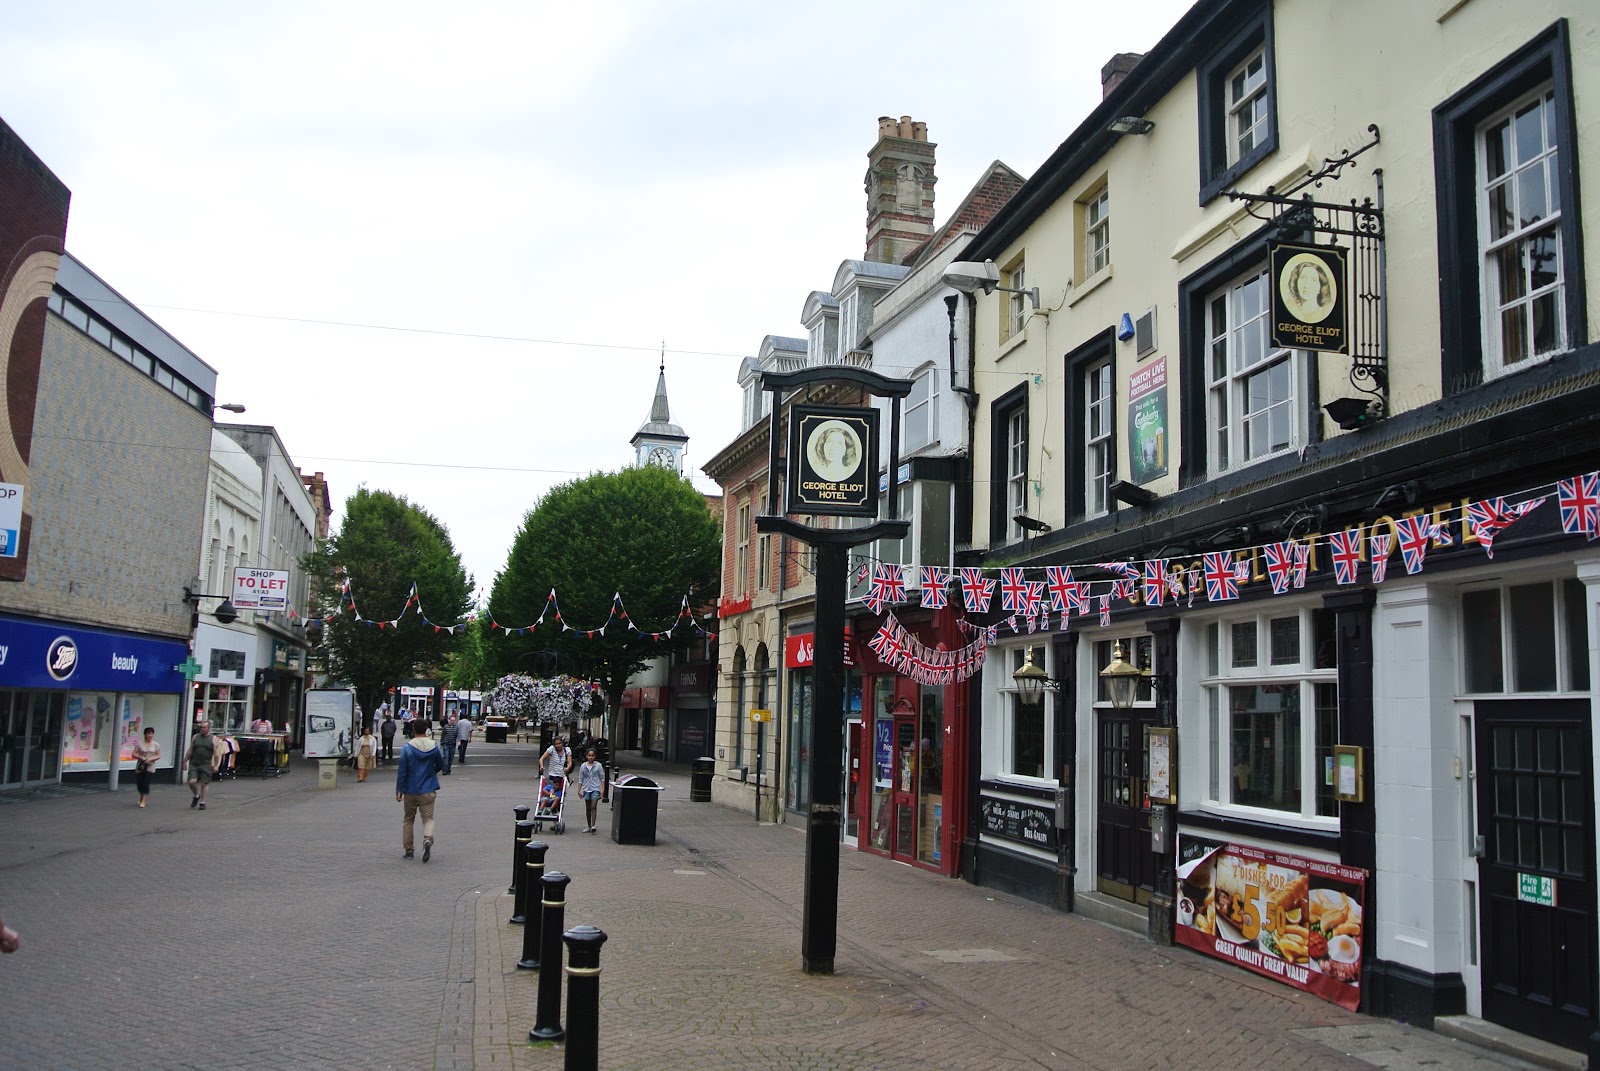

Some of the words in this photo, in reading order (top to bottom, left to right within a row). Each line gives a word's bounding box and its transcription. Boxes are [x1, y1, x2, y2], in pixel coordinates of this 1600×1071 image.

[1278, 323, 1313, 334] GEORGE
[1316, 327, 1341, 337] ELIOT
[1295, 334, 1324, 345] HOTEL
[1130, 380, 1152, 397] FOOTBALL
[1152, 373, 1165, 386] HERE
[802, 481, 837, 491] GEORGE
[839, 483, 864, 492] ELIOT
[819, 491, 848, 500] HOTEL
[250, 570, 275, 578] SHOP
[237, 577, 256, 588] TO
[260, 578, 286, 590] LET
[111, 652, 139, 674] beauty
[1233, 865, 1238, 878] 2
[1240, 866, 1268, 887] DISHES
[1269, 872, 1286, 890] FOR
[1340, 868, 1349, 878] FISH
[1353, 871, 1364, 881] CHIPS
[1522, 873, 1538, 886] Fire
[1522, 884, 1538, 895] exit
[1520, 893, 1537, 903] Keep
[1536, 896, 1552, 906] clear
[1215, 938, 1236, 957] GREAT
[1235, 946, 1264, 968] QUALITY
[1263, 955, 1286, 975] GREAT
